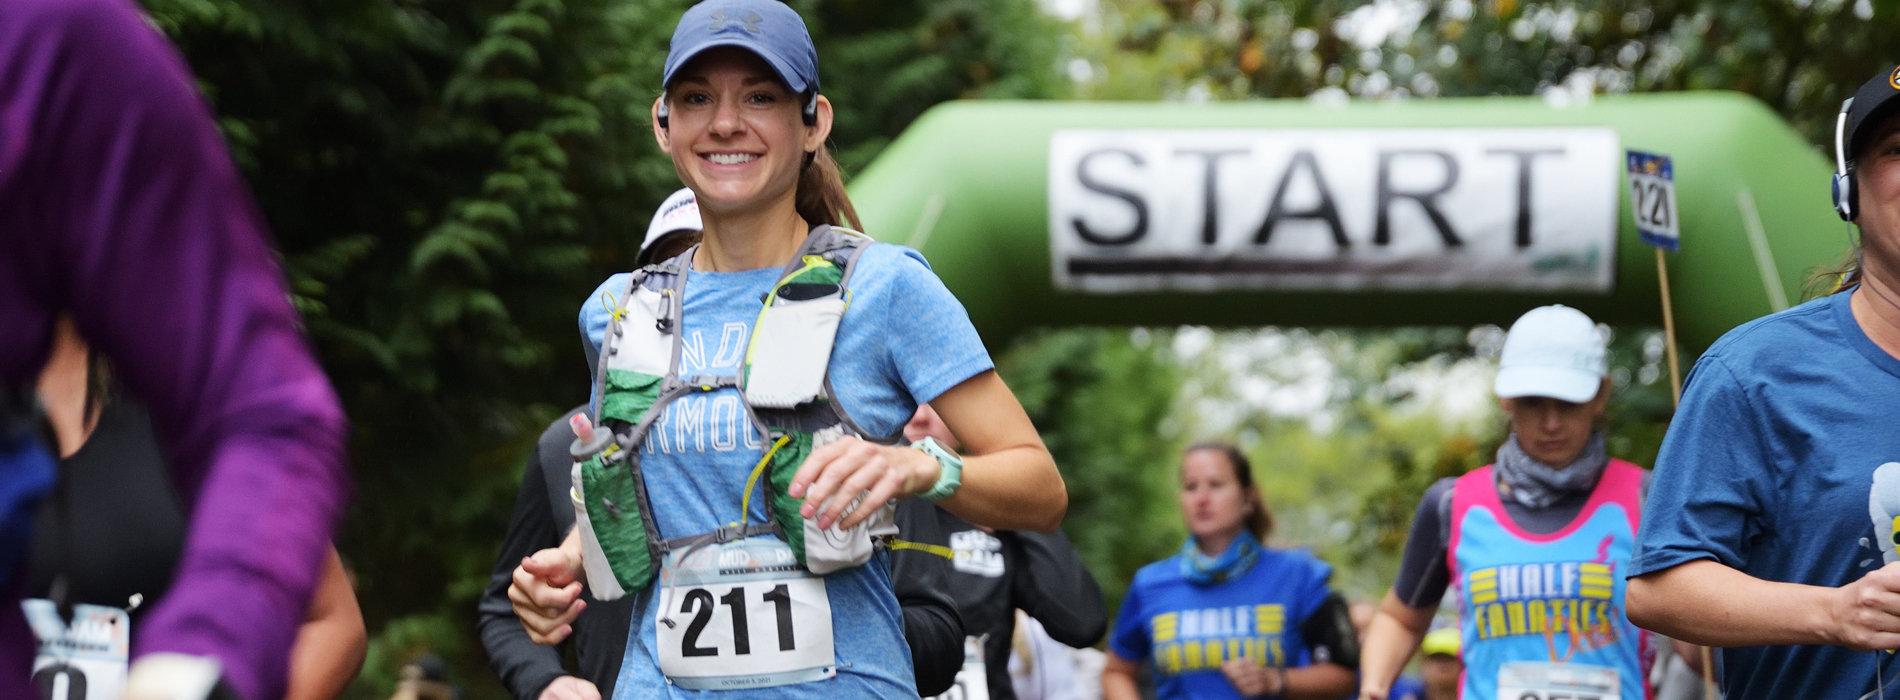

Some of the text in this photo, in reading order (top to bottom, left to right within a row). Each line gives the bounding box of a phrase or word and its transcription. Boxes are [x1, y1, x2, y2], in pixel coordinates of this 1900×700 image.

[1071, 147, 1566, 249] START
[1632, 180, 1671, 228] 221
[645, 395, 762, 454] RMOU
[670, 550, 716, 570] 2021
[718, 548, 798, 568] MUD DA
[1498, 561, 1581, 600] HALF
[680, 583, 796, 657] 211
[1475, 598, 1610, 641] FANATICS
